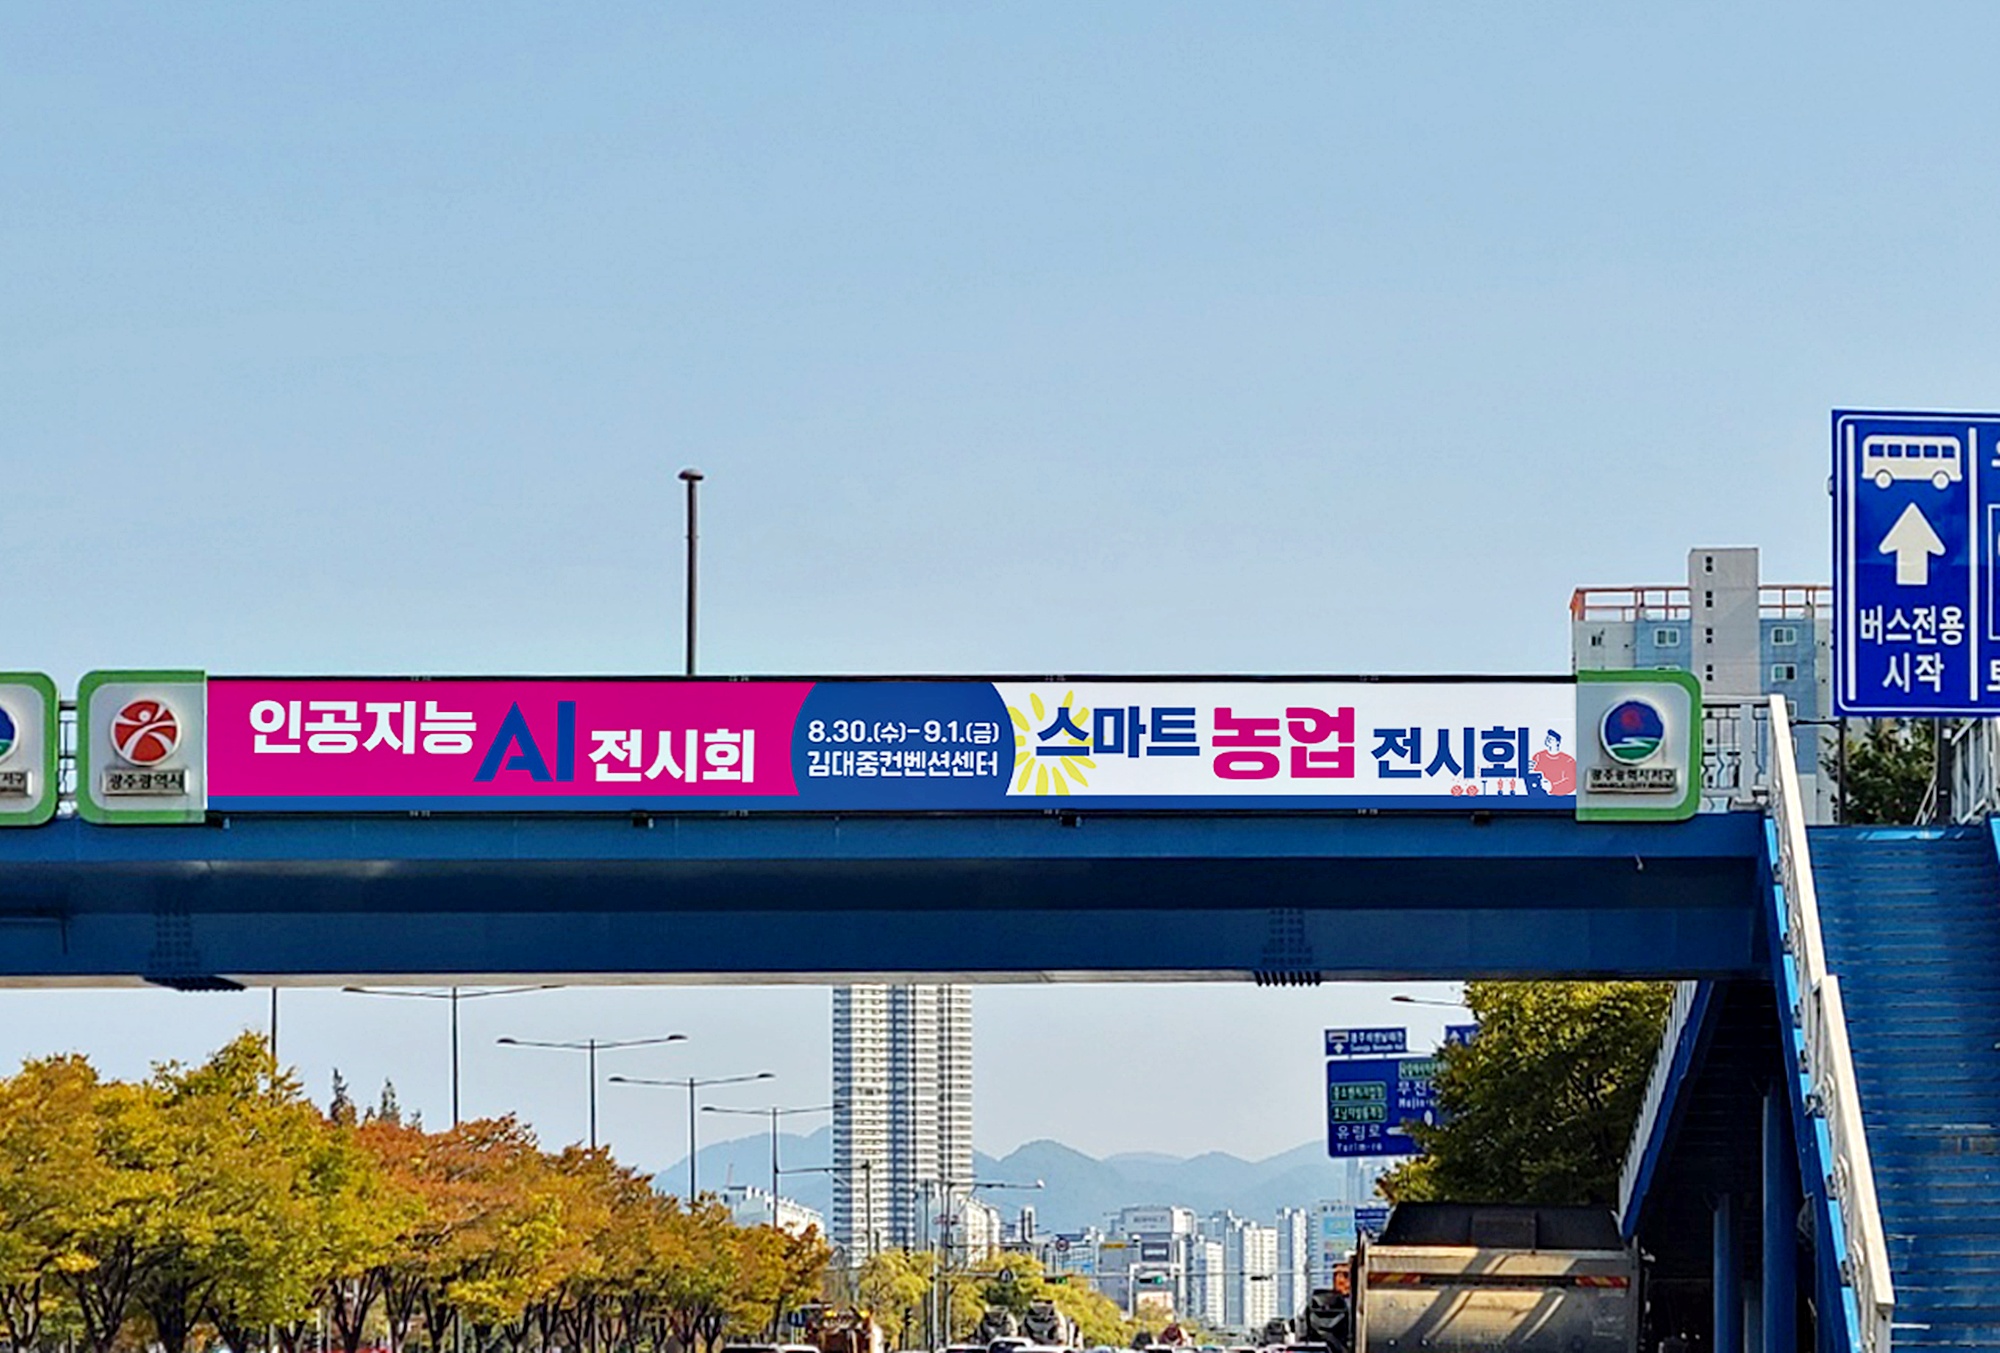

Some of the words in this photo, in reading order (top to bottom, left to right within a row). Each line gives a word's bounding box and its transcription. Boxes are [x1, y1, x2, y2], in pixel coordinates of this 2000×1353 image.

[1860, 605, 1965, 645] 버스전용
[1882, 652, 1945, 693] 시작
[249, 699, 476, 755] 인공지능
[473, 700, 576, 782] AI
[588, 728, 755, 783] 전시회
[1035, 705, 1201, 759] 스마트
[1212, 707, 1355, 780] 농업
[1370, 725, 1529, 779] 전시회
[110, 773, 184, 790] 광주광역시
[807, 750, 998, 777] 김대중컨벤션센터
